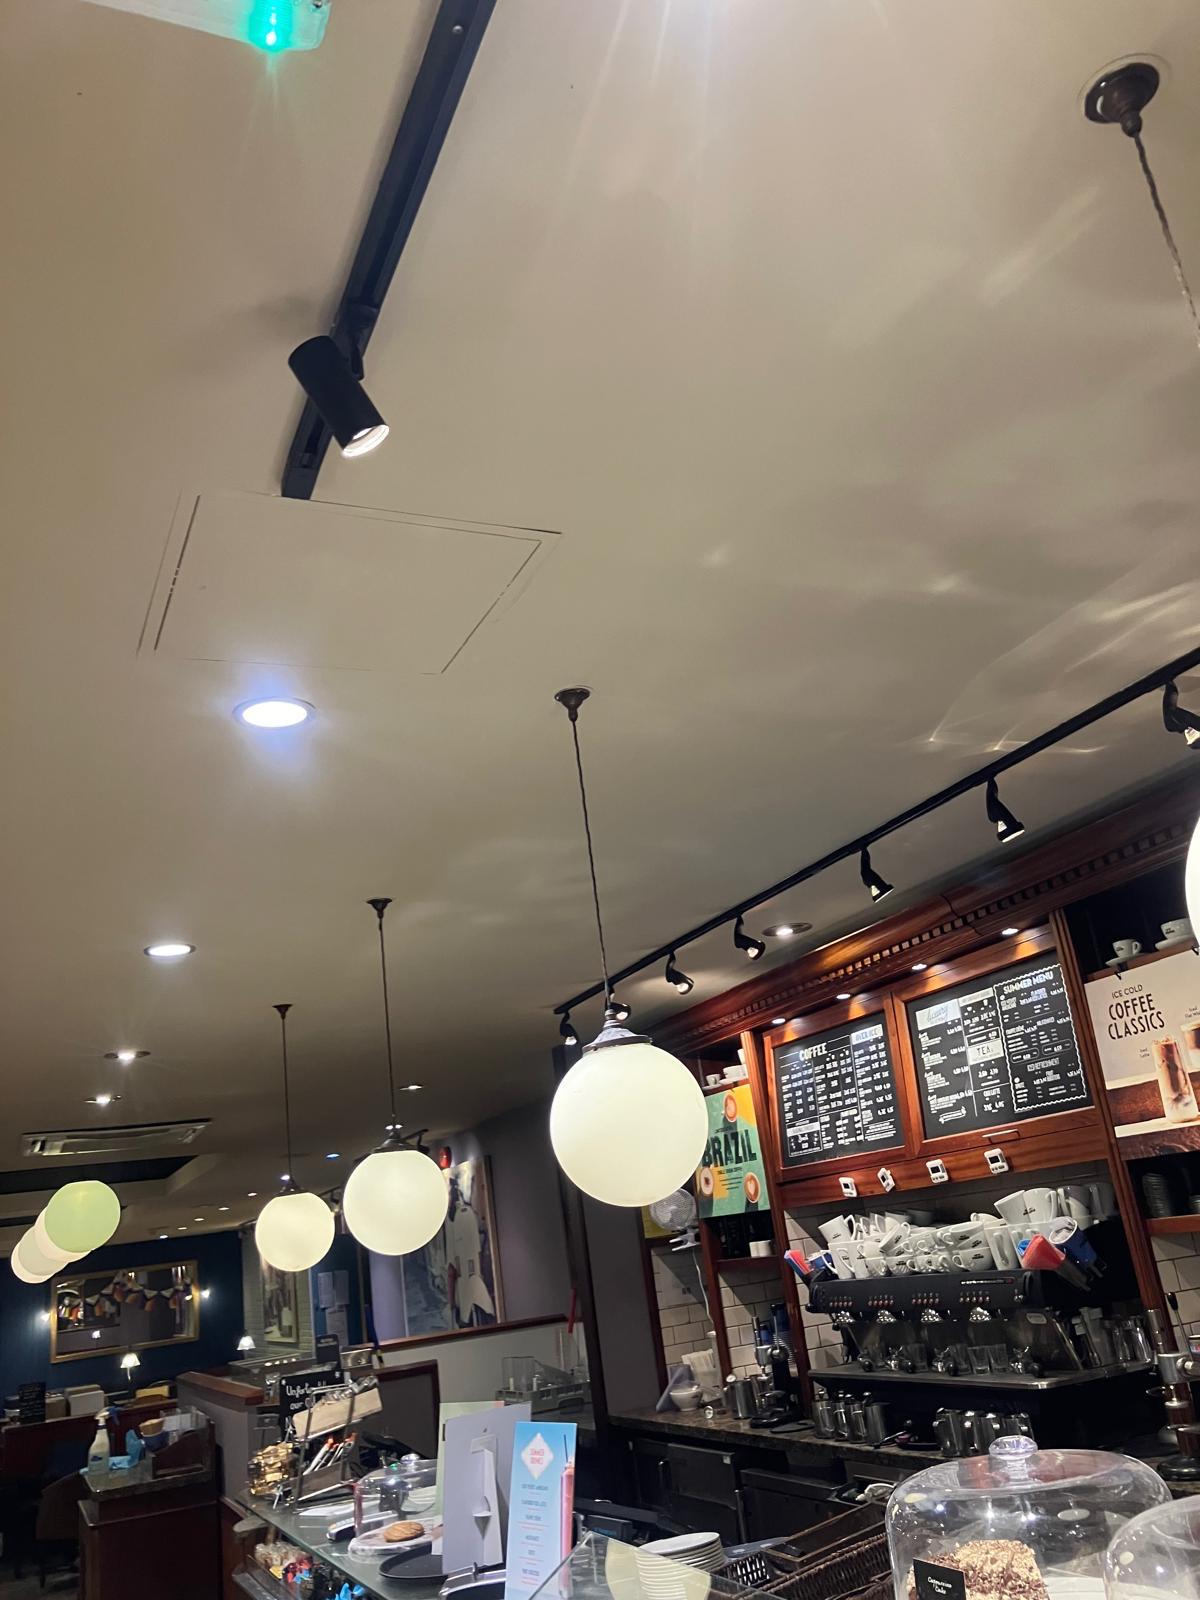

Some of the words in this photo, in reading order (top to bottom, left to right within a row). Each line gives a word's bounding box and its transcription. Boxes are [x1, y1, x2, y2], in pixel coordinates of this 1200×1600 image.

[1003, 978, 1033, 994] SUMMER
[1033, 971, 1054, 985] MENU
[1111, 990, 1123, 999] ICE
[1124, 984, 1143, 996] COLD
[1108, 993, 1155, 1021] COFFEE
[1108, 1011, 1165, 1040] CLASSICS
[799, 1042, 829, 1061] COFFEE
[702, 1129, 757, 1168] BRAZIL
